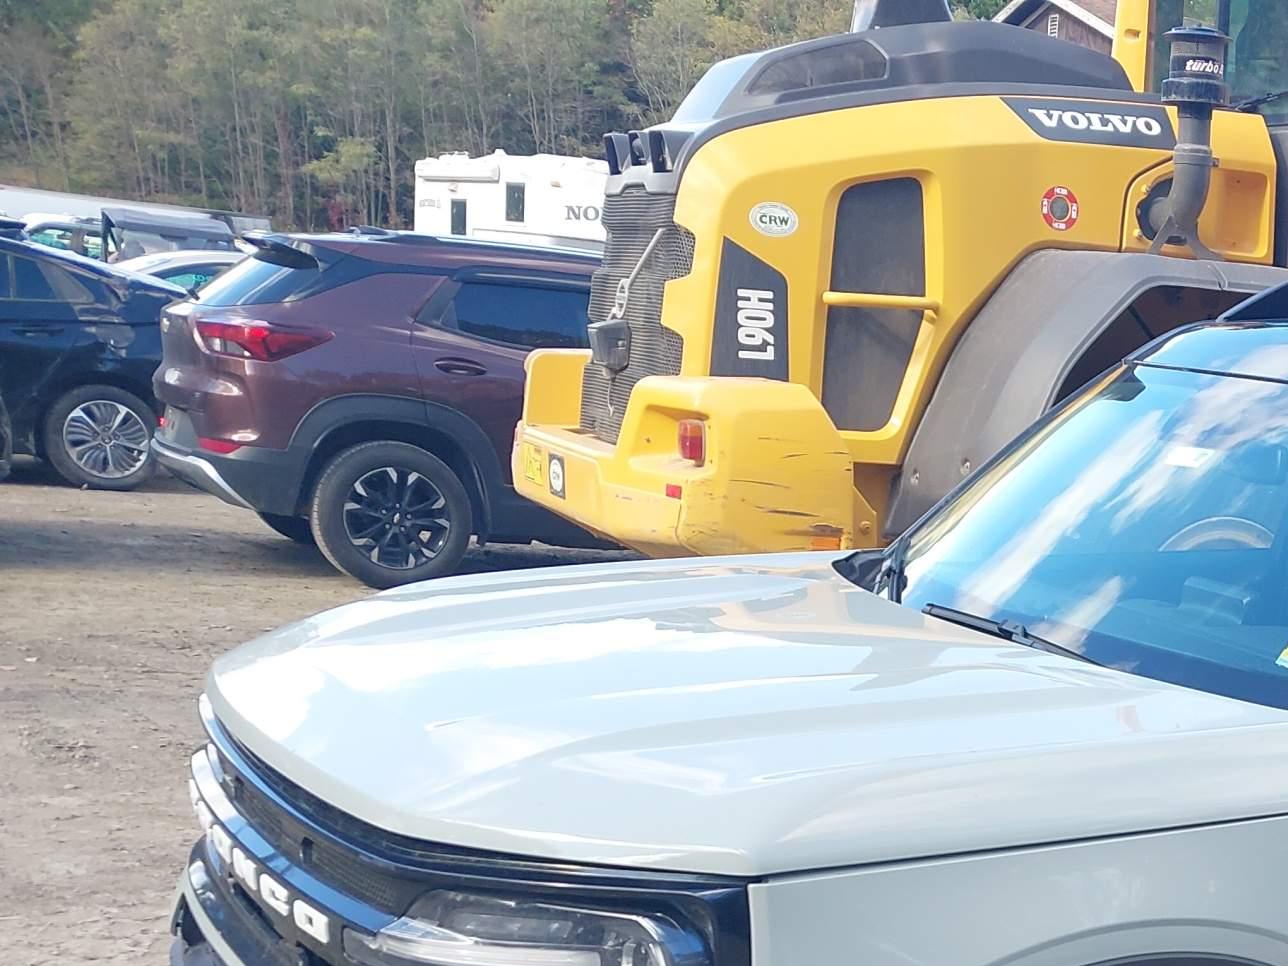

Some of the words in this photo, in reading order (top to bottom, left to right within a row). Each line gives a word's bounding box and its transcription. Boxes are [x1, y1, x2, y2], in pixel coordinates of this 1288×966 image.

[1185, 59, 1219, 74] turbo
[1027, 107, 1162, 136] VOLVO
[565, 205, 603, 221] NO
[758, 214, 791, 227] CRW
[736, 288, 775, 361] L90H
[189, 778, 329, 944] ONCO
